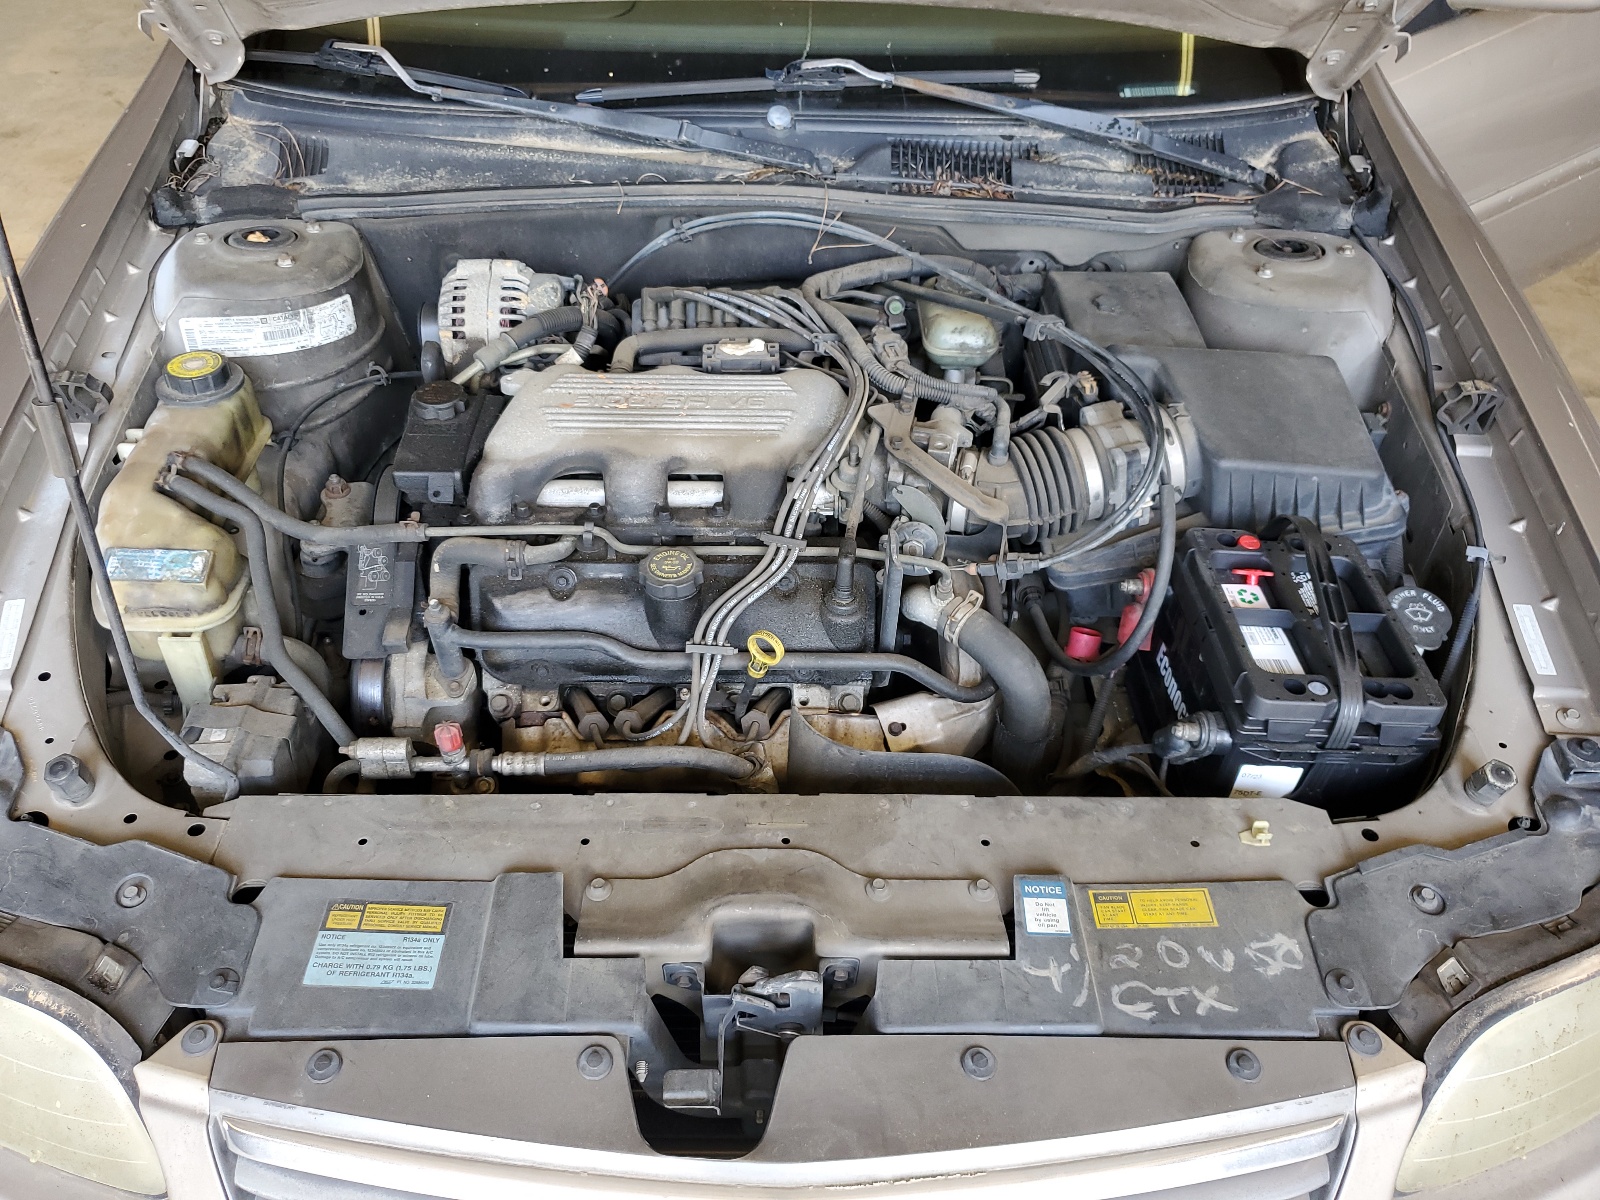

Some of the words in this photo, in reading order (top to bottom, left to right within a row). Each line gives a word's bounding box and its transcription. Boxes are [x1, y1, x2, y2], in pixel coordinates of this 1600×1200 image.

[653, 550, 680, 561] ENGINE
[1391, 589, 1417, 609] WASHER
[1422, 592, 1445, 612] FLUID
[1412, 624, 1435, 633] ONLY
[1156, 642, 1189, 720] ECONOC
[1024, 885, 1063, 894] NOTICE
[340, 903, 364, 911] CAUTION
[395, 964, 412, 972] (1.75
